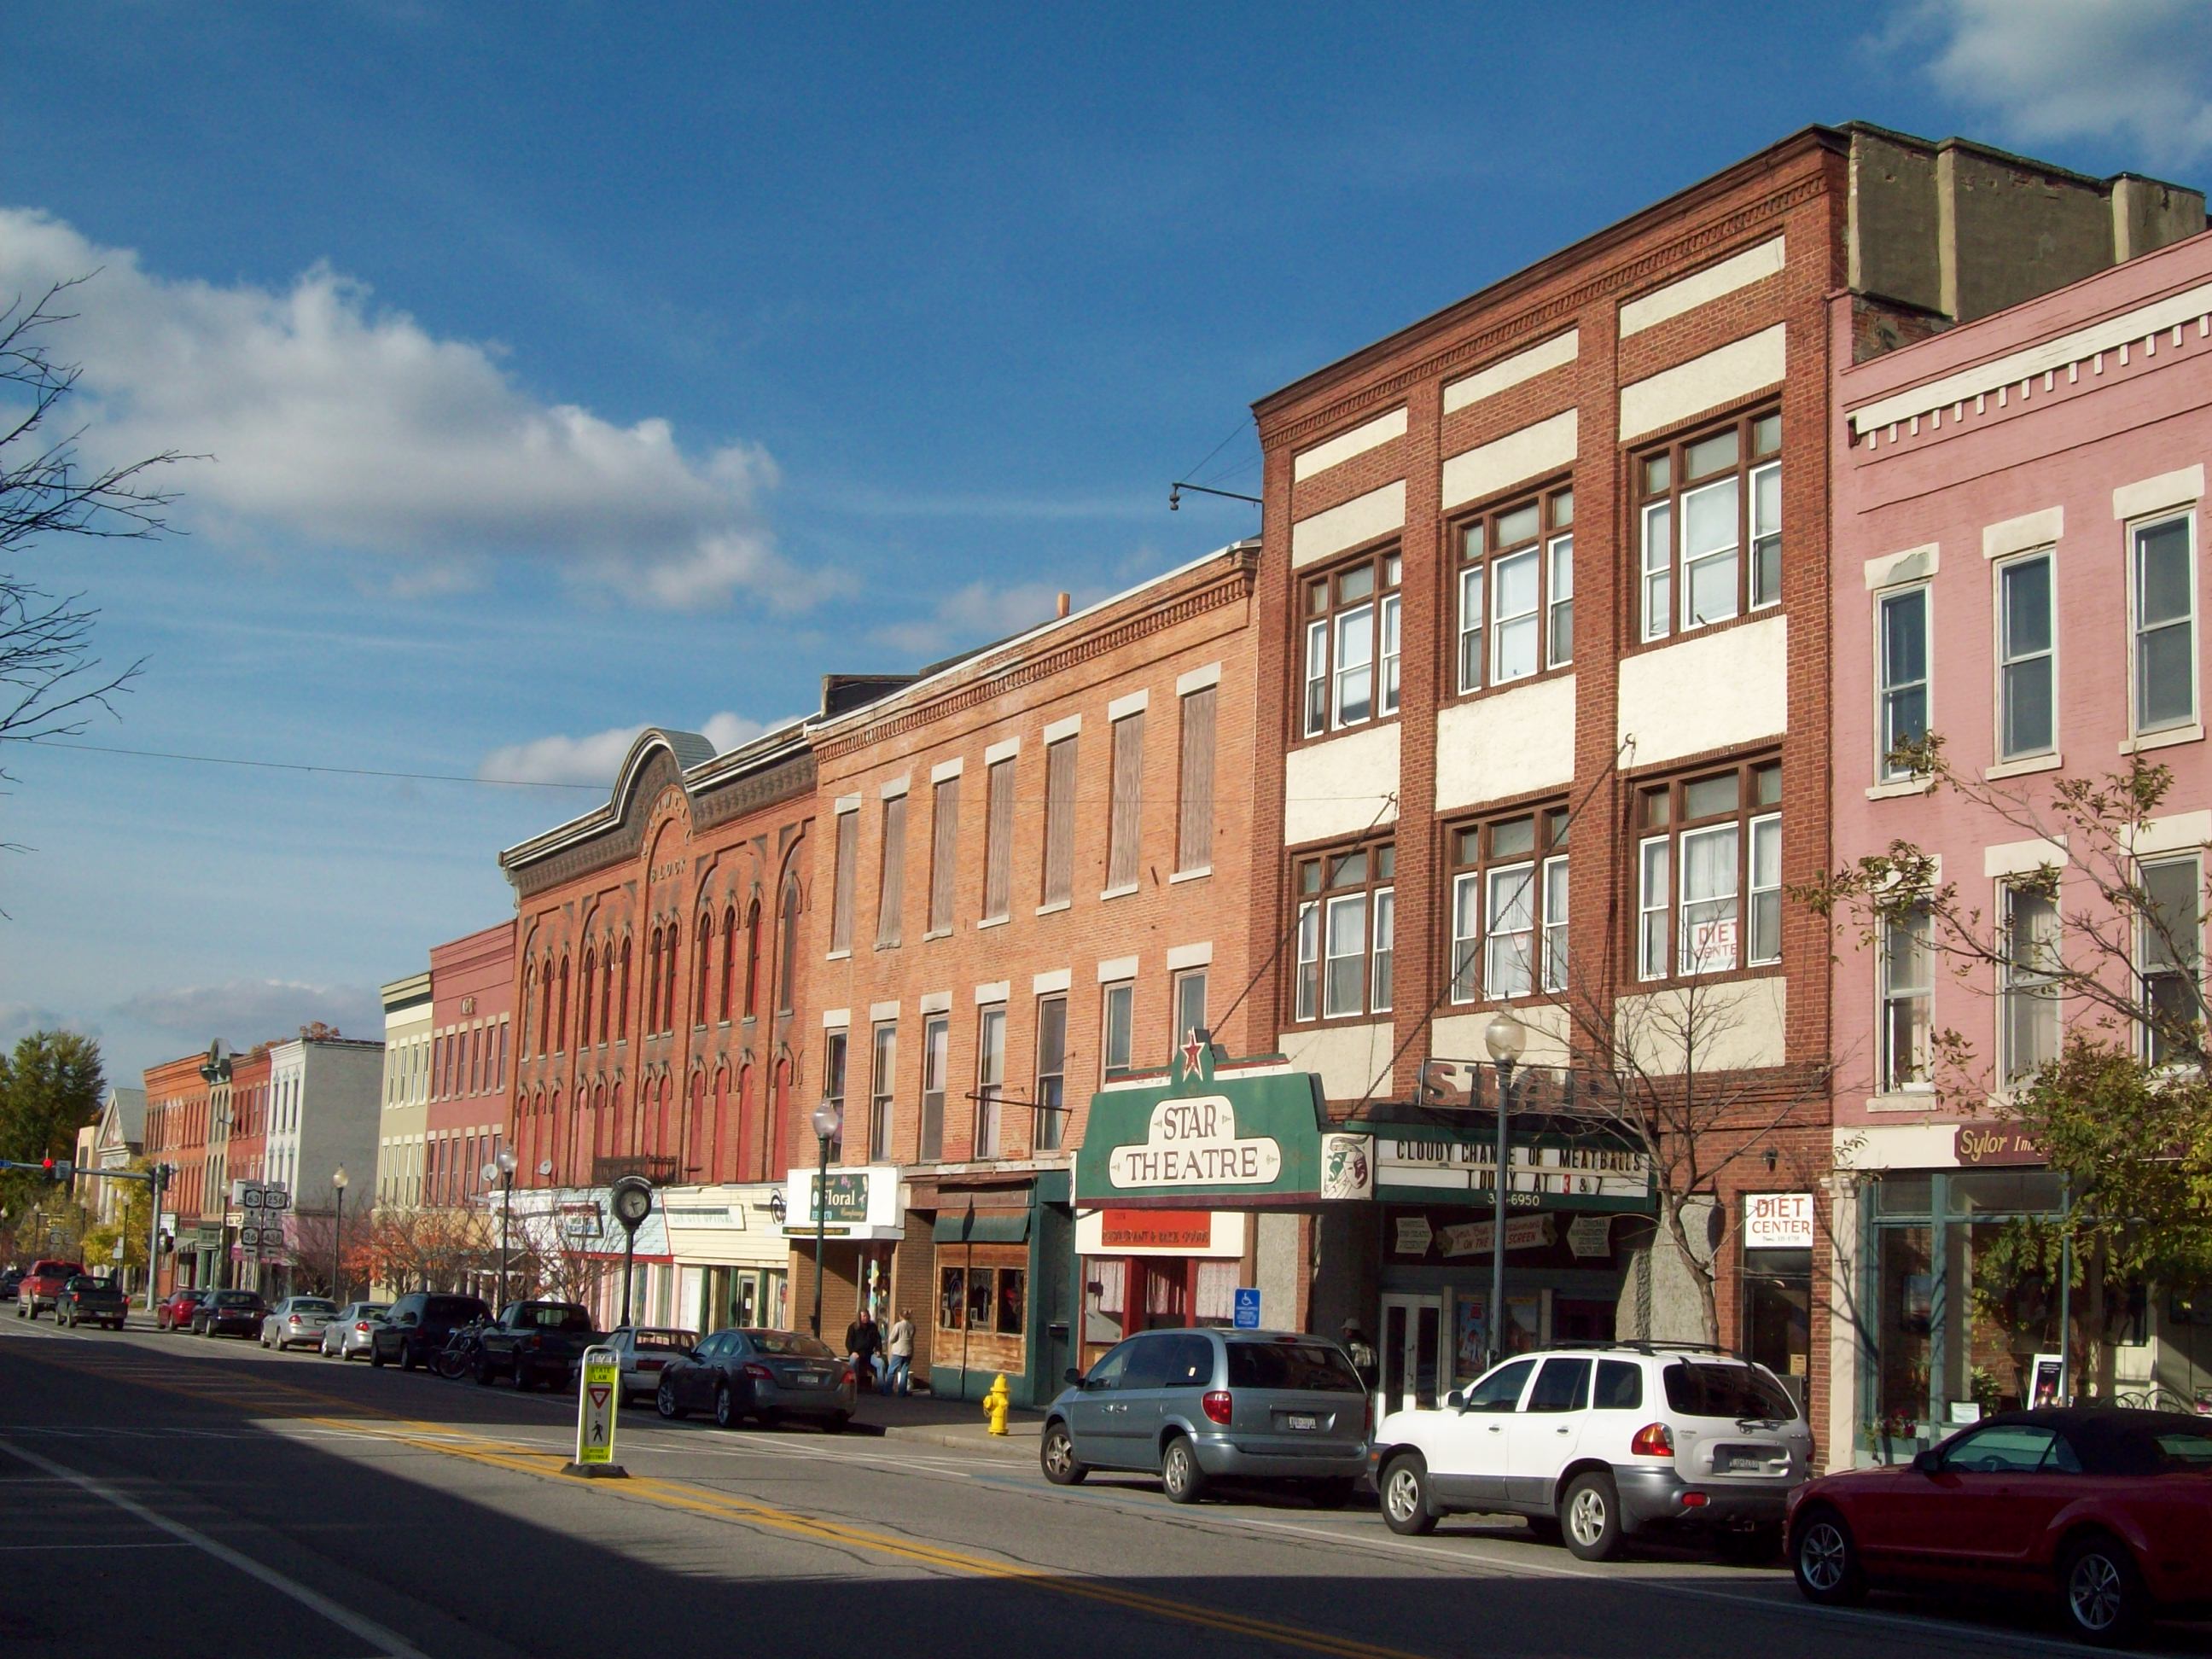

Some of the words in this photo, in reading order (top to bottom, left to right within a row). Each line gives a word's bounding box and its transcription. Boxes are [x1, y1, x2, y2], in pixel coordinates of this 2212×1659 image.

[650, 859, 686, 883] BLOCK
[1163, 1104, 1217, 1141] STAR
[1396, 1140, 1452, 1161] CLOUDY
[1461, 1144, 1516, 1166] CHANE
[1528, 1148, 1543, 1167] OF
[1559, 1150, 1641, 1172] MEATBALLS
[1960, 1129, 2008, 1162] Sylor
[1126, 1146, 1259, 1181] THEATRE
[1467, 1169, 1516, 1190] TODY
[1534, 1173, 1549, 1193] AT
[1563, 1174, 1571, 1195] 3
[1579, 1177, 1588, 1193] &
[1596, 1176, 1604, 1195] 7
[267, 1195, 284, 1204] 256
[1487, 1192, 1540, 1207] 3-6950
[1756, 1198, 1805, 1219] DIET
[244, 1231, 256, 1241] 36
[1752, 1220, 1811, 1236] CENTER
